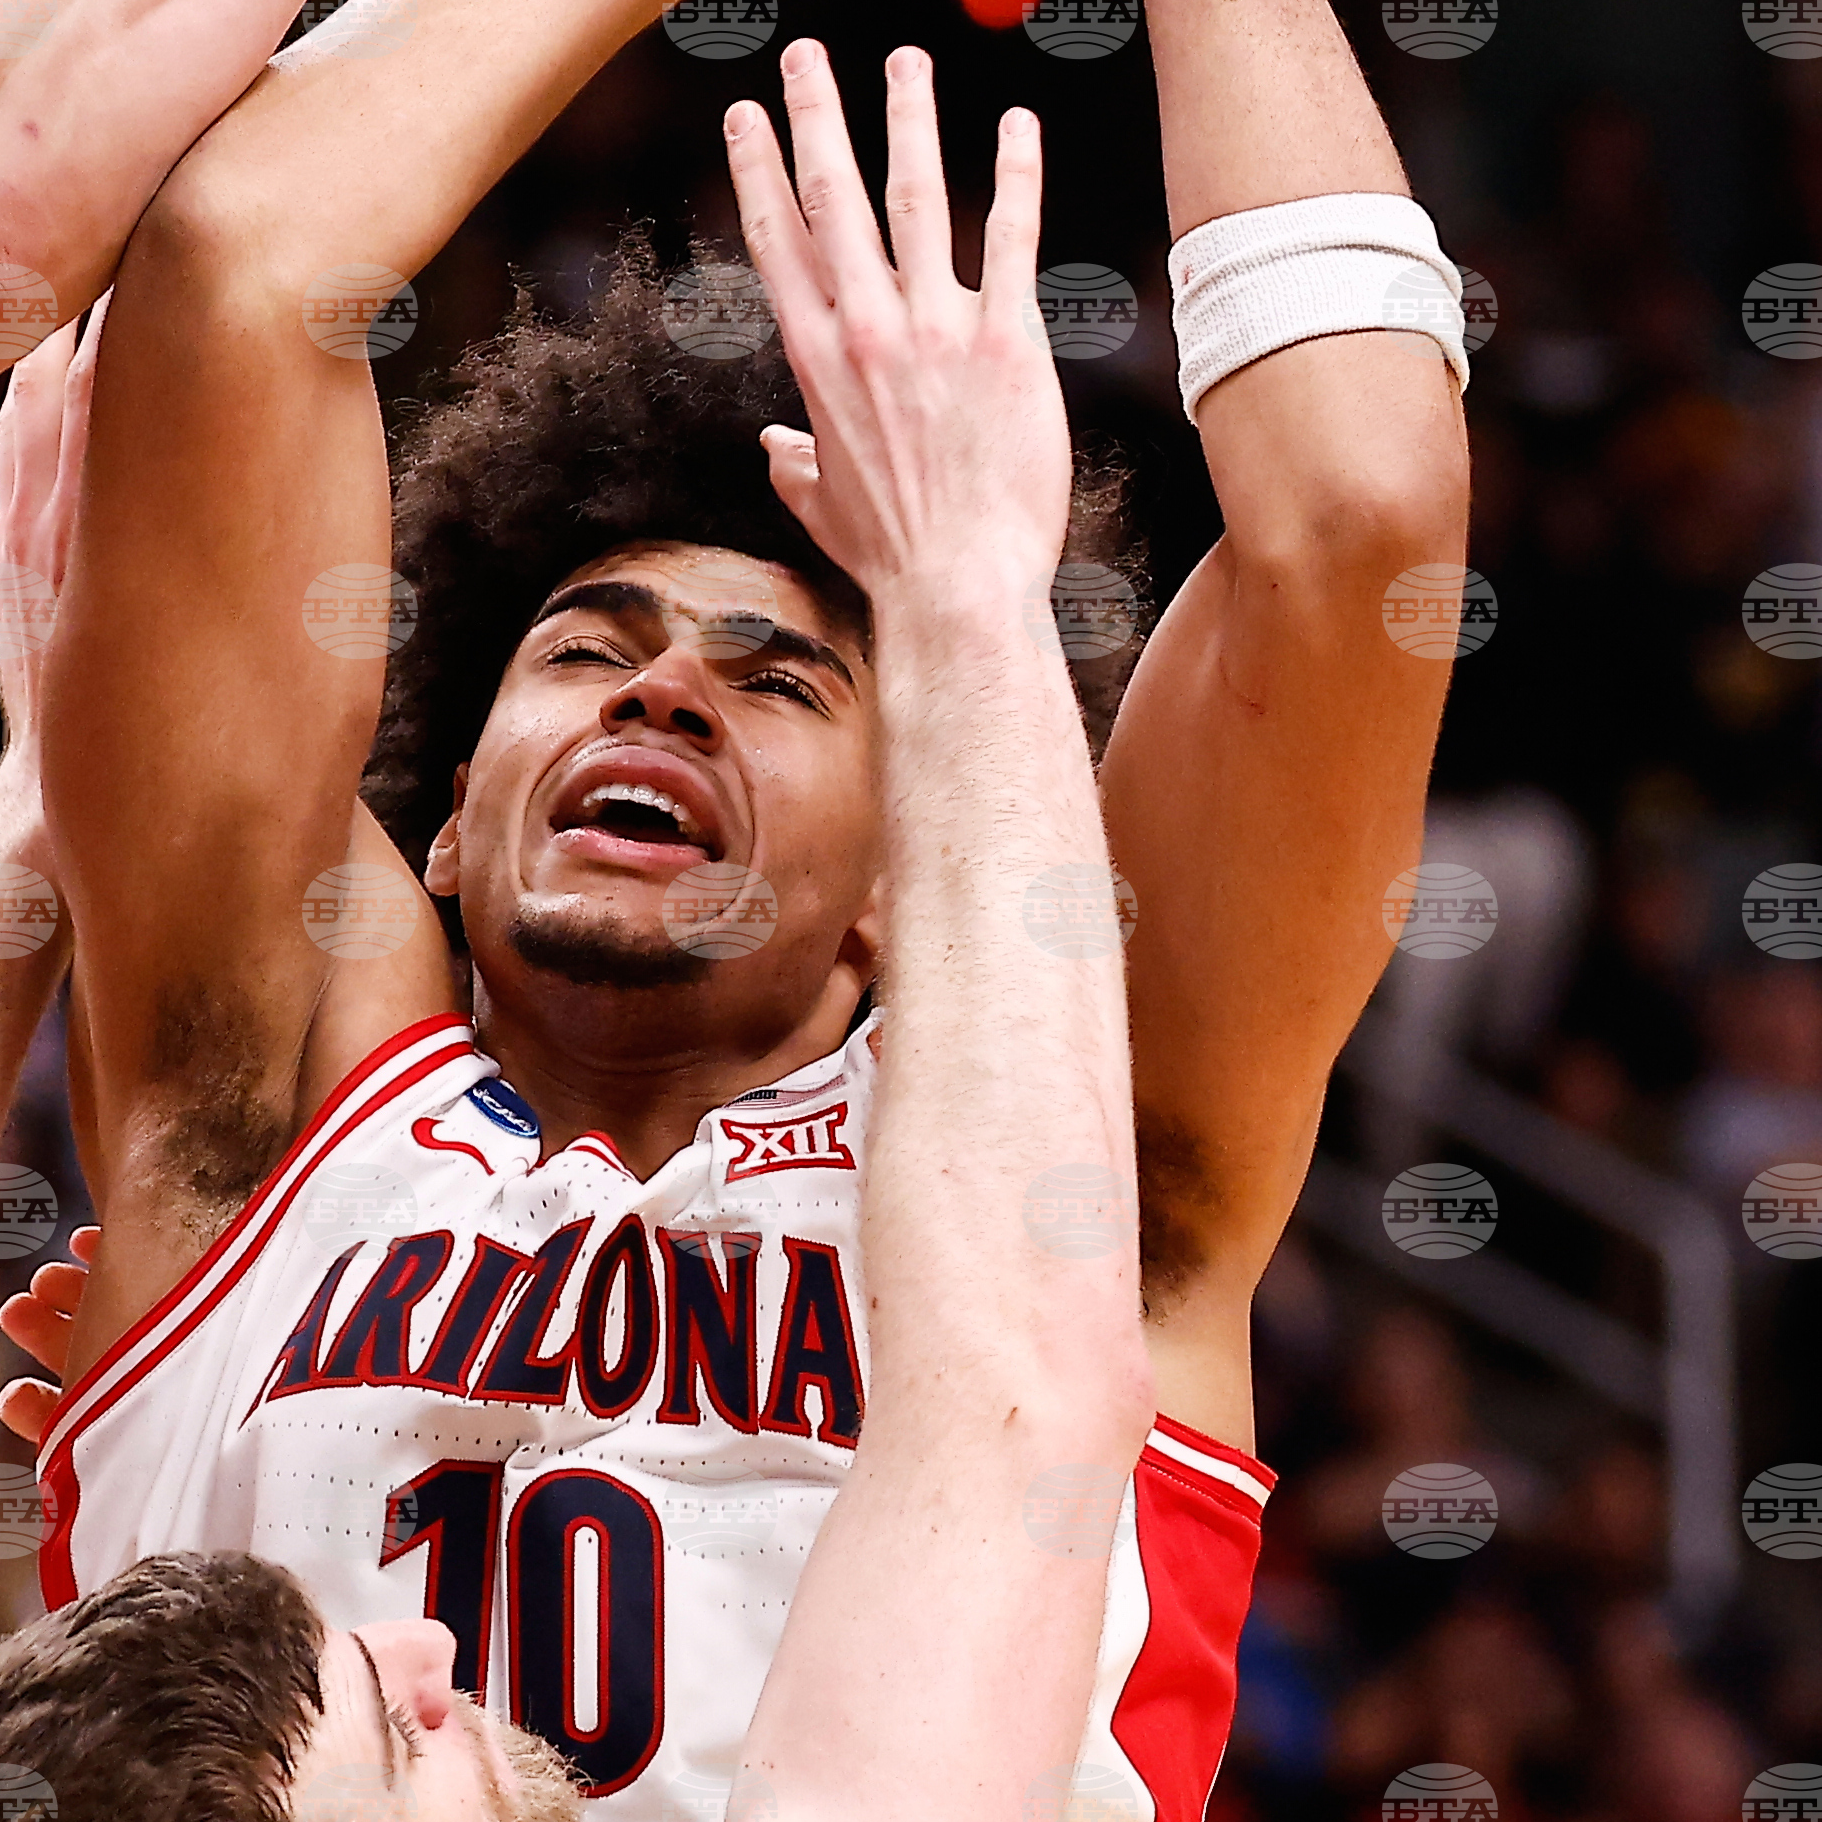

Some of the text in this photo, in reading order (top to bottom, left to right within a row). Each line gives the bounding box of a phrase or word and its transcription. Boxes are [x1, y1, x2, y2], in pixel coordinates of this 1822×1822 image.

[730, 1111, 845, 1173] XII
[238, 1213, 864, 1449] ARIZONA
[379, 1459, 664, 1801] 10
